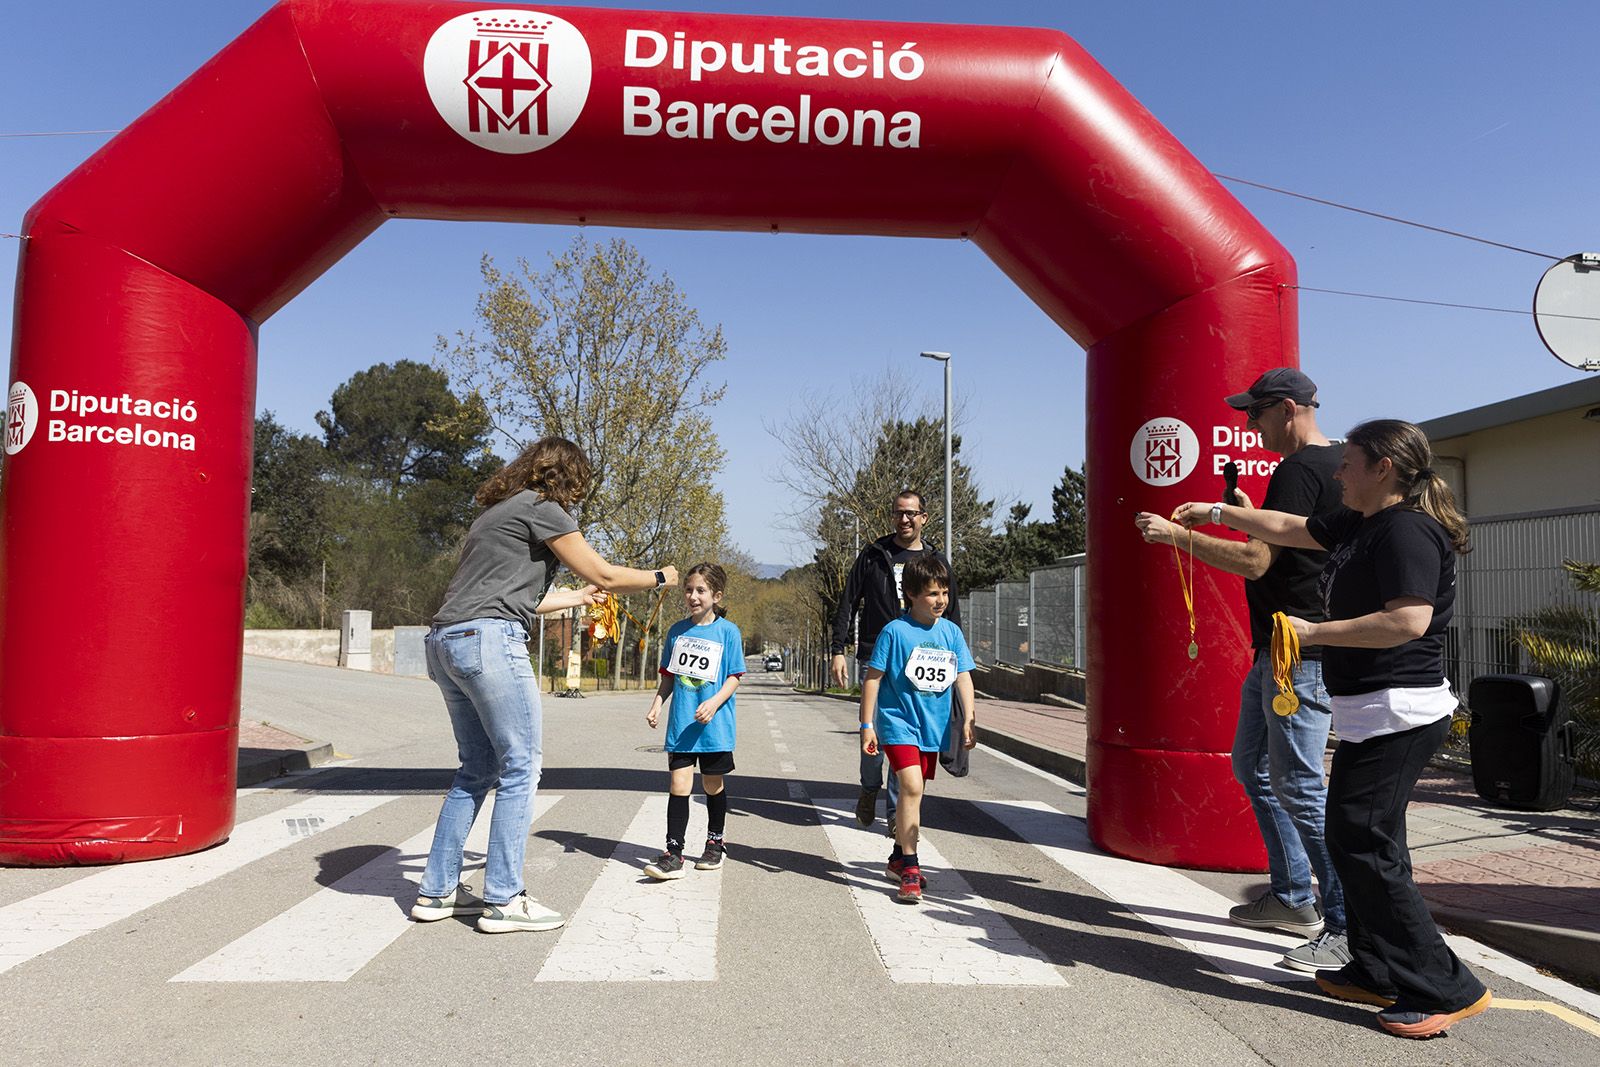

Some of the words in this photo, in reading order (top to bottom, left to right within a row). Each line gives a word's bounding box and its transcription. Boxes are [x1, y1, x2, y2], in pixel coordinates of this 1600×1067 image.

[623, 28, 926, 82] Diputació
[622, 85, 922, 149] Barcelona
[49, 389, 198, 422] Diputació
[48, 419, 197, 451] Barcelona
[1213, 454, 1284, 476] Barce
[679, 653, 709, 670] 079
[914, 667, 945, 682] 035
